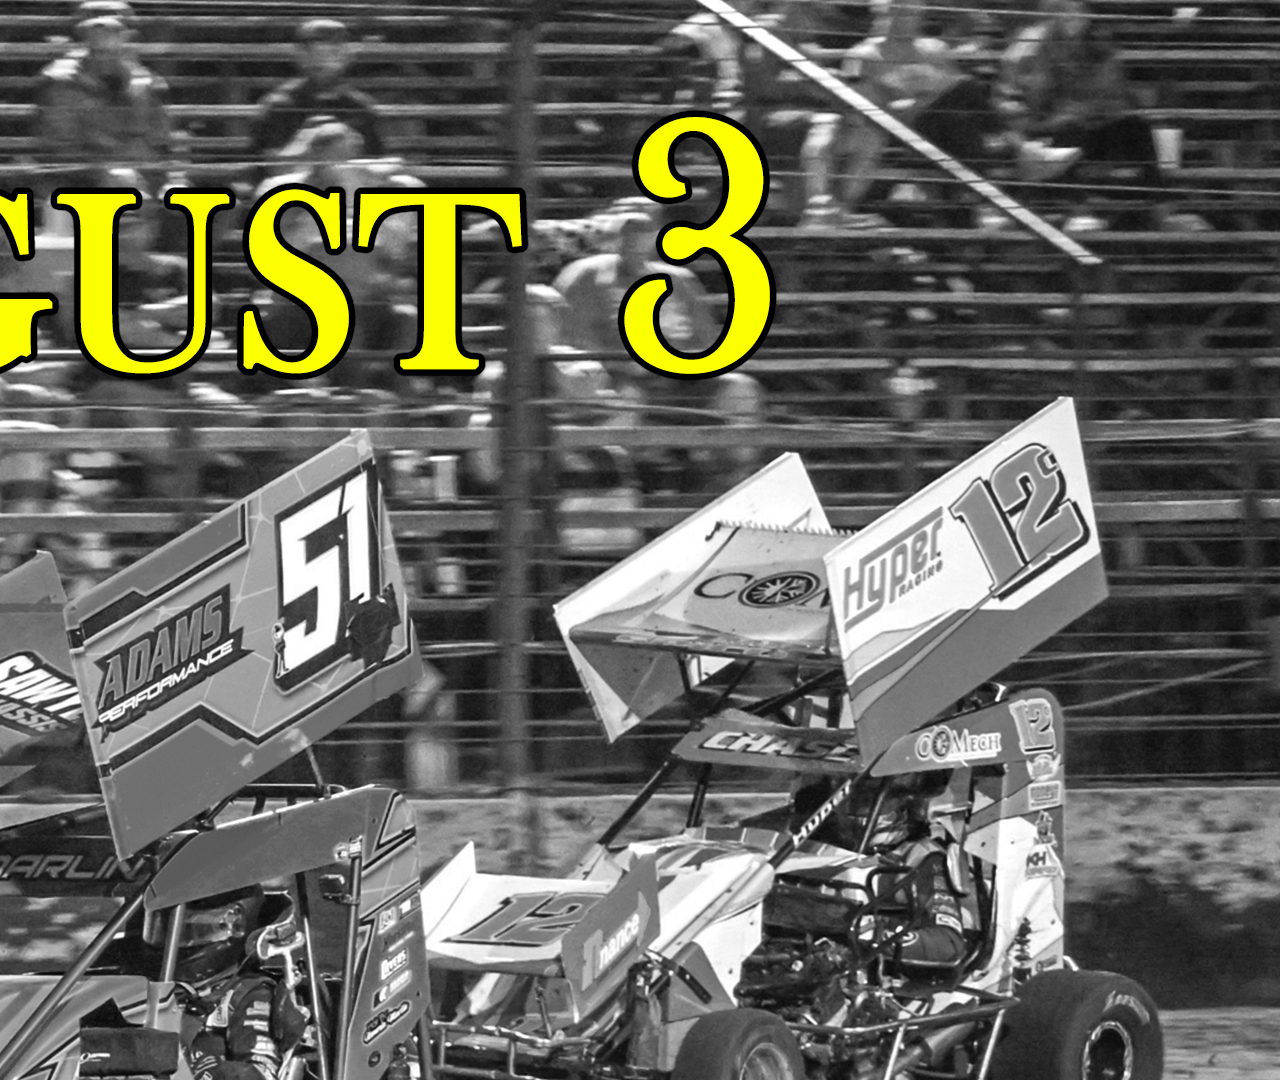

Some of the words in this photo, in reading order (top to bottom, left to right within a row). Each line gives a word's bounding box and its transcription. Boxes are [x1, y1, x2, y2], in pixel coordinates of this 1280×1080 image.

[280, 470, 371, 676] 51
[898, 560, 944, 598] RACING
[98, 594, 223, 710] ADAMS
[98, 638, 235, 724] PERFORMANCE
